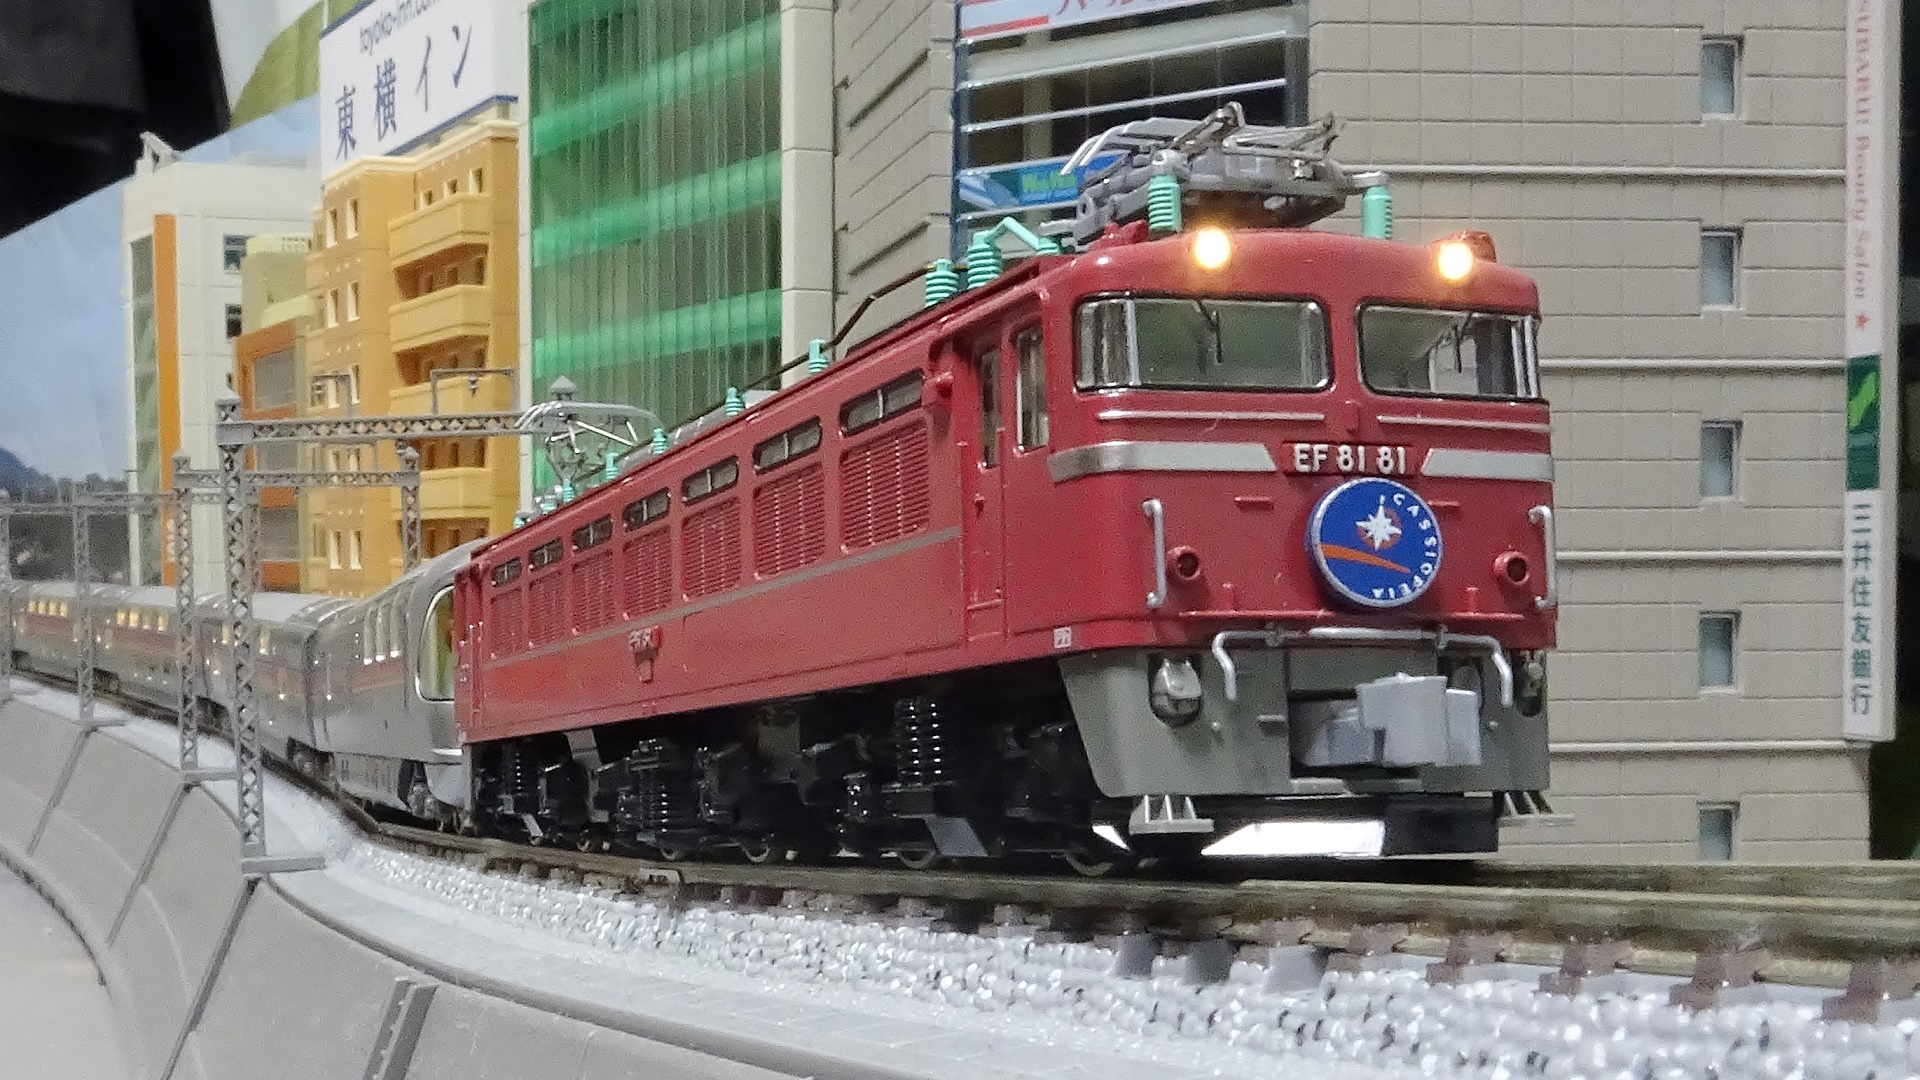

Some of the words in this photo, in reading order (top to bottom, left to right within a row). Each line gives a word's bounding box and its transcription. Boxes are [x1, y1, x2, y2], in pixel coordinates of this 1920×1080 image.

[334, 25, 473, 161] 東横イン
[1293, 443, 1329, 473] EF
[1336, 444, 1366, 473] 81
[1376, 446, 1407, 475] 81
[1372, 493, 1437, 599] CASSIOPEIA
[1852, 503, 1872, 716] 三井住友銀行
